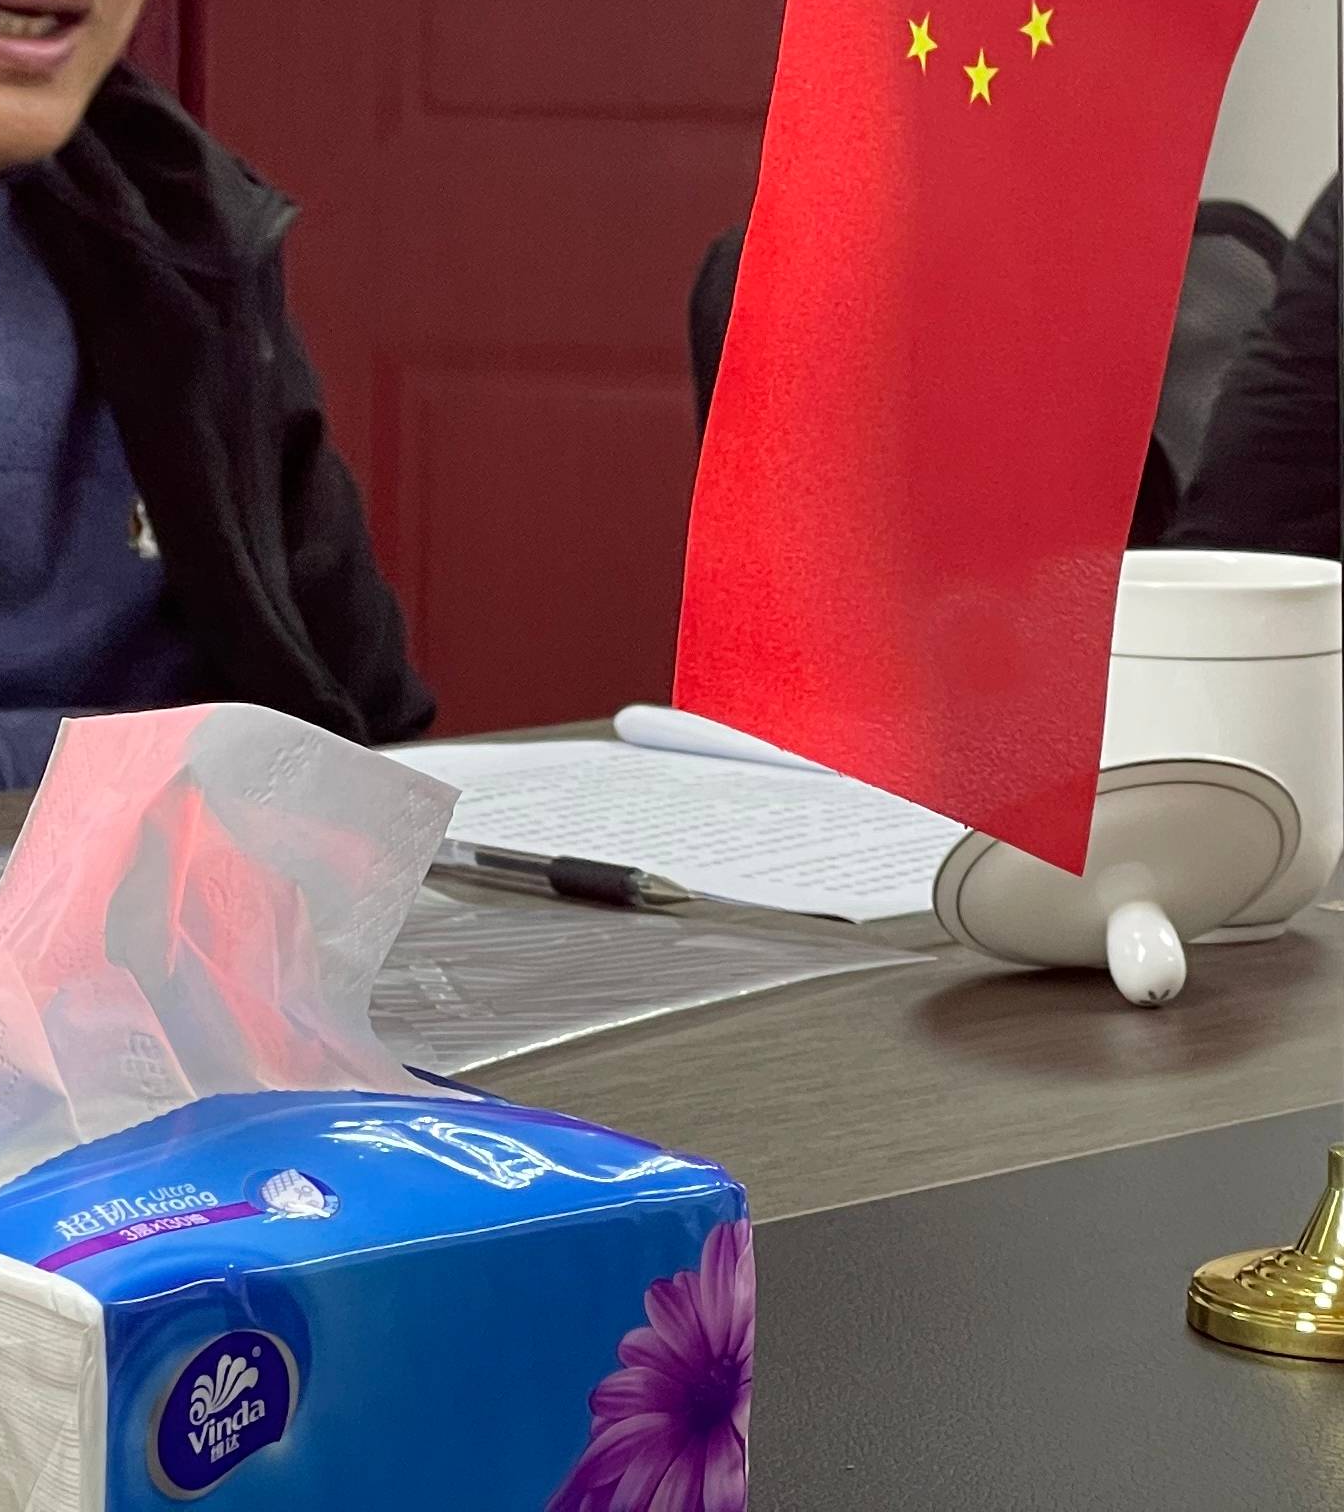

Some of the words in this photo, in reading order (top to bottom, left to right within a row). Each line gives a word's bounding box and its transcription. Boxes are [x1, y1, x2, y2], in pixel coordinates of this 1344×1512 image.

[135, 1190, 219, 1217] Strong
[148, 1183, 197, 1202] Ultra
[53, 1197, 138, 1241] 超韧
[187, 1399, 265, 1456] Vinda
